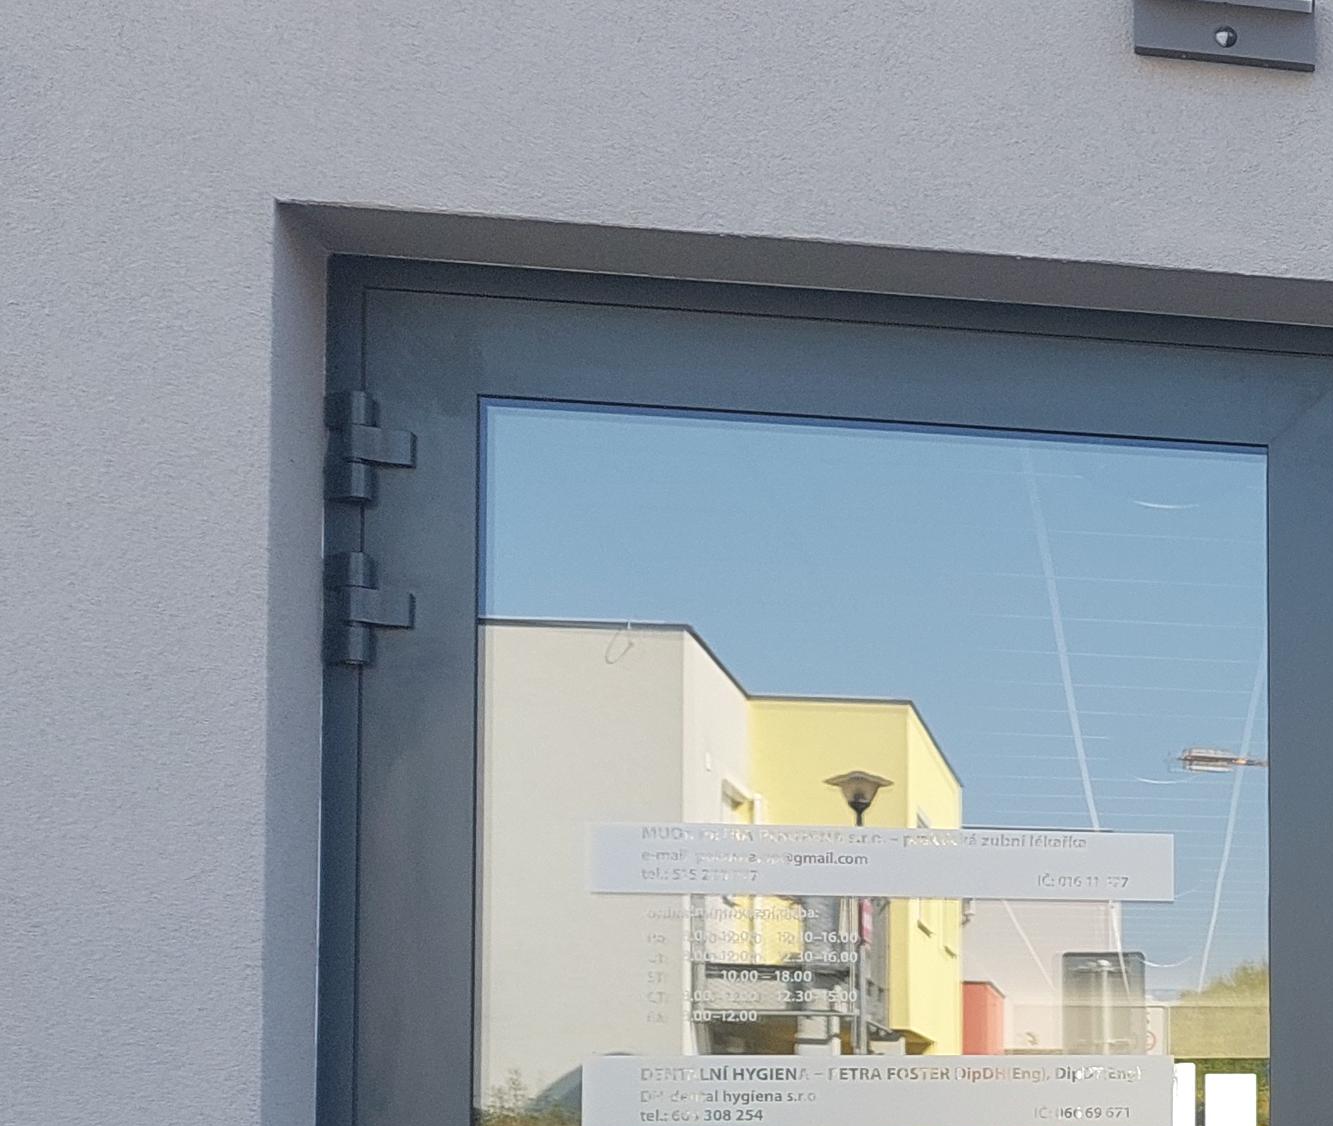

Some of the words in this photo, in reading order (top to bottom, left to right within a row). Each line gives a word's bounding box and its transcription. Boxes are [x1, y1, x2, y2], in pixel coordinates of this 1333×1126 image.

[981, 833, 1025, 847] zubní
[1030, 834, 1087, 848] lékařka
[720, 970, 758, 982] 10.00
[775, 970, 812, 982] 18.00
[684, 1009, 758, 1022] .00–12.00
[641, 1065, 728, 1081] DENTLNÍ
[732, 1067, 810, 1080] HYGIENA
[887, 1067, 951, 1081] FOSTER
[671, 1089, 718, 1102] denal
[722, 1089, 783, 1106] hygiena
[640, 1109, 668, 1122] tel.:
[703, 1109, 732, 1121] 308
[735, 1109, 763, 1121] 254
[1085, 1107, 1102, 1118] 69
[1106, 1107, 1129, 1118] 671
